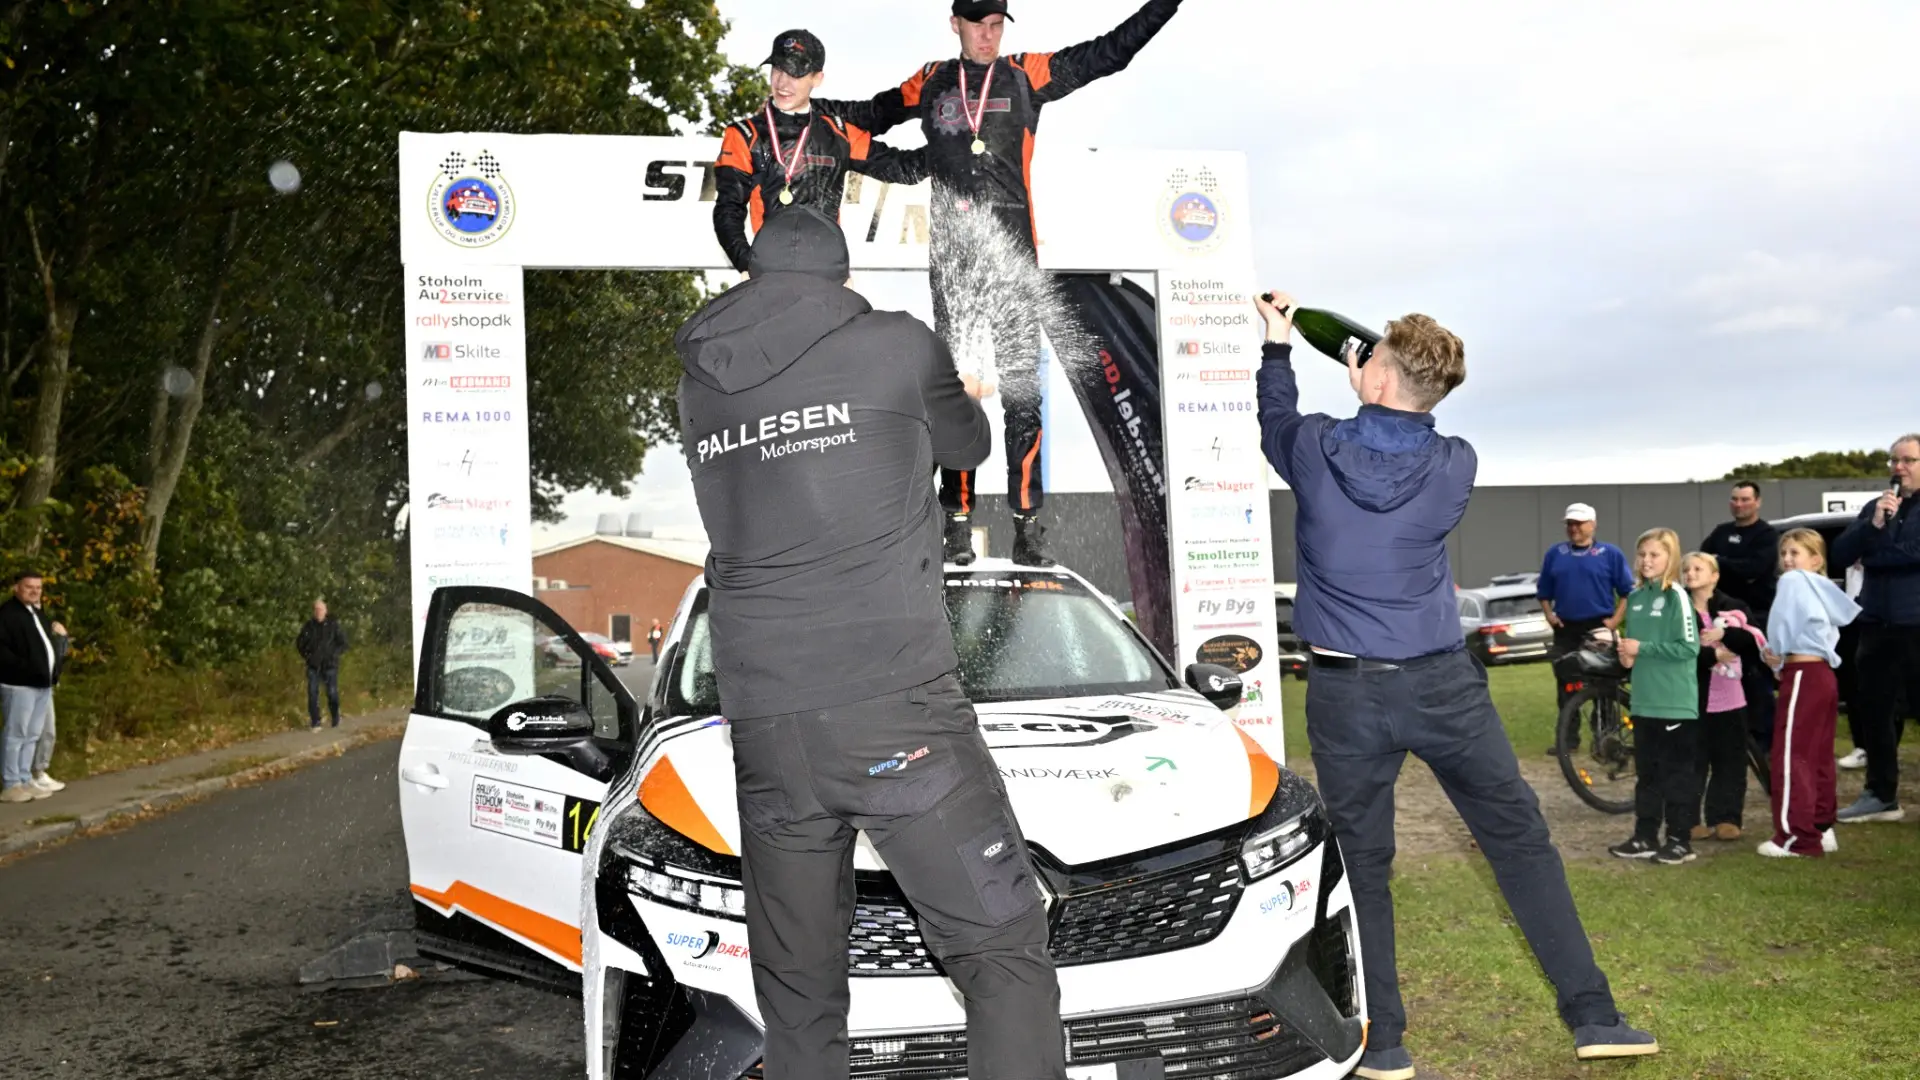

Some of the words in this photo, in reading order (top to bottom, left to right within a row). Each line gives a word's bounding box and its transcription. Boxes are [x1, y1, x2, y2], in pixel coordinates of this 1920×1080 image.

[418, 275, 482, 287] Stoholm
[1170, 280, 1224, 290] Stoholm
[455, 344, 501, 359] Skilte
[1203, 342, 1241, 354] Skilte
[1178, 402, 1218, 412] REMA
[1222, 401, 1252, 412] 1000
[422, 411, 470, 423] REMA
[476, 411, 511, 421] 1000
[697, 402, 850, 463] PALLESEN
[760, 428, 857, 462] Motorsport
[1216, 480, 1254, 495] Slagter
[1187, 550, 1259, 561] Smollerup
[942, 578, 1065, 590] andel.dk
[1198, 599, 1221, 616] Fly
[1225, 599, 1255, 615] Byg
[979, 723, 1099, 733] ECH
[868, 759, 899, 776] SUPER
[998, 766, 1121, 779] ÅNDVÆRK
[476, 783, 493, 795] RALLY
[475, 794, 503, 808] STOHOLM
[1260, 892, 1289, 914] SUPER
[666, 932, 704, 949] SUPER
